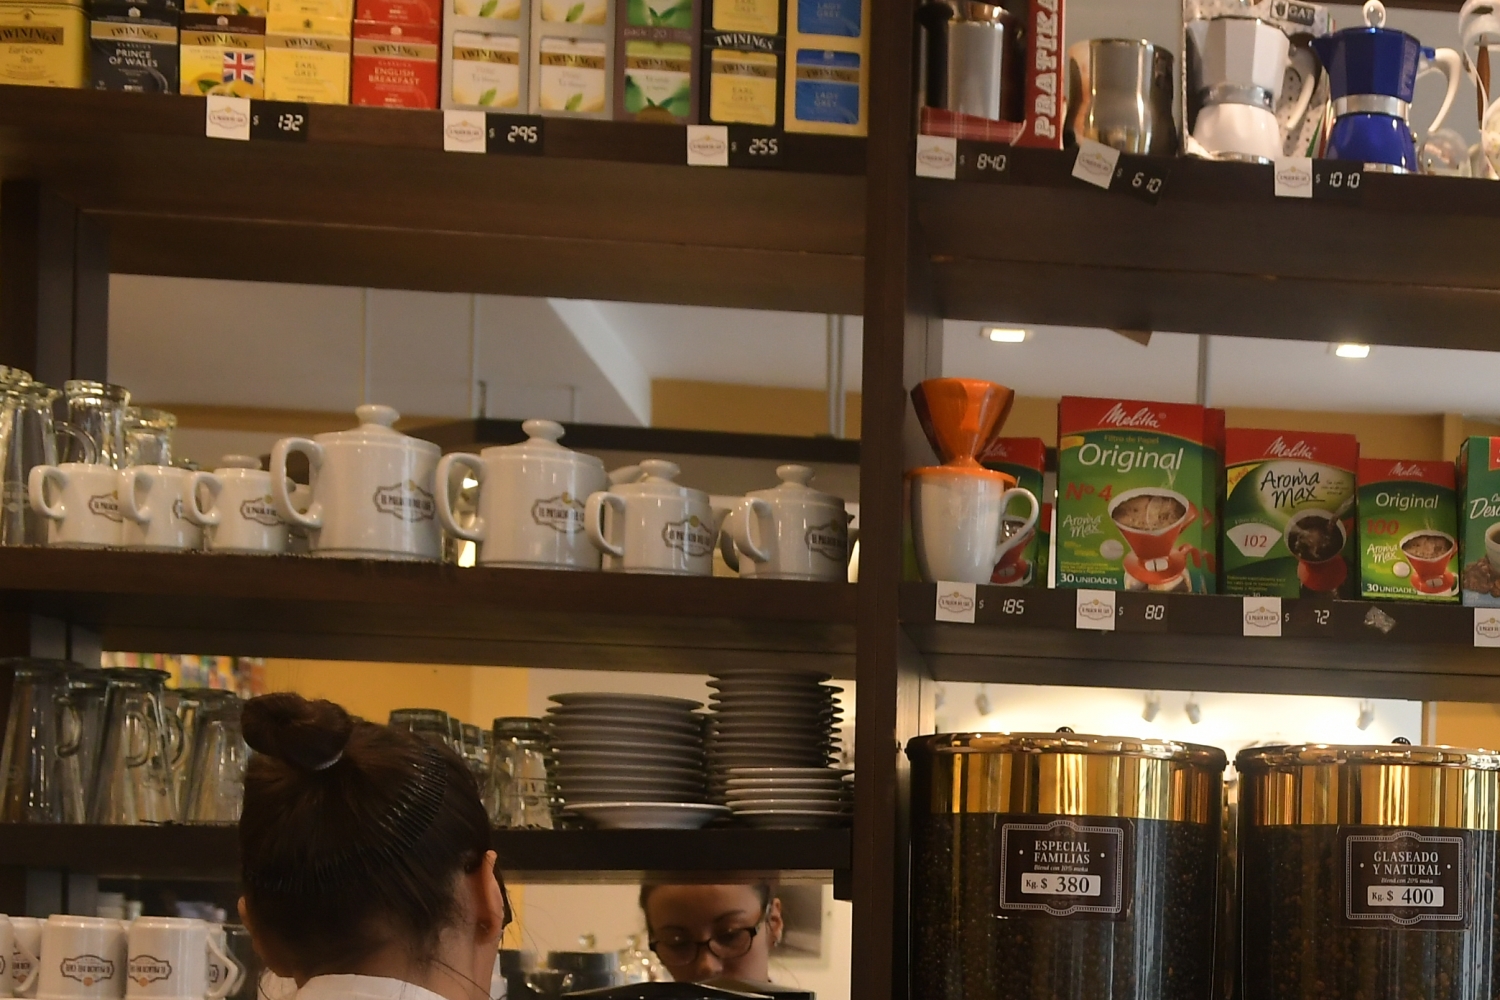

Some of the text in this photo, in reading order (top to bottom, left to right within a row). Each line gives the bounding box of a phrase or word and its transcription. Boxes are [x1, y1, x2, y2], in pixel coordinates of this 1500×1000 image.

[1288, 6, 1315, 19] GAT
[110, 26, 161, 40] TWININGS
[196, 33, 249, 48] TWININGS
[284, 36, 334, 51] TWININGS
[715, 33, 774, 50] TWININGS
[115, 48, 150, 59] PRINCE
[372, 44, 420, 57] TWININGS
[461, 50, 512, 63] TWININGS
[109, 56, 158, 68] OF WALES
[547, 54, 598, 69] TWININGS
[634, 58, 682, 72] TWININGS
[374, 67, 414, 77] ENGLISH
[722, 63, 767, 77] TWININGS
[804, 68, 851, 82] TWININGS
[368, 74, 420, 85] BREAKFAST
[278, 114, 304, 131] 132
[507, 126, 538, 143] 295
[748, 138, 779, 155] 255
[976, 153, 1006, 171] 840
[1328, 172, 1361, 189] 1010
[1098, 403, 1160, 428] Melitta
[1263, 435, 1316, 460] Melitta
[1078, 443, 1184, 473] Original
[1388, 461, 1425, 478] Melitta
[1260, 467, 1321, 492] Aroma
[1098, 483, 1114, 498] 4
[1376, 492, 1439, 511] Original
[1063, 513, 1102, 529] Aroma
[1367, 518, 1400, 536] 100
[1244, 534, 1267, 548] 102
[1366, 541, 1399, 556] Aroma
[1060, 572, 1118, 585] 30 UNIDADES
[1366, 583, 1418, 595] 30 UNIDADES
[1002, 599, 1025, 615] 185
[1145, 605, 1165, 620] 80
[1314, 609, 1330, 625] 72
[1035, 840, 1090, 853] ESPECIAL
[1034, 852, 1090, 864] FAMILIAS
[1374, 851, 1439, 863] GLASEADO
[1373, 864, 1441, 876] Y NATURAL
[1025, 876, 1090, 893] Kg. $ 380
[1386, 890, 1394, 901] $
[1401, 888, 1434, 904] 400
